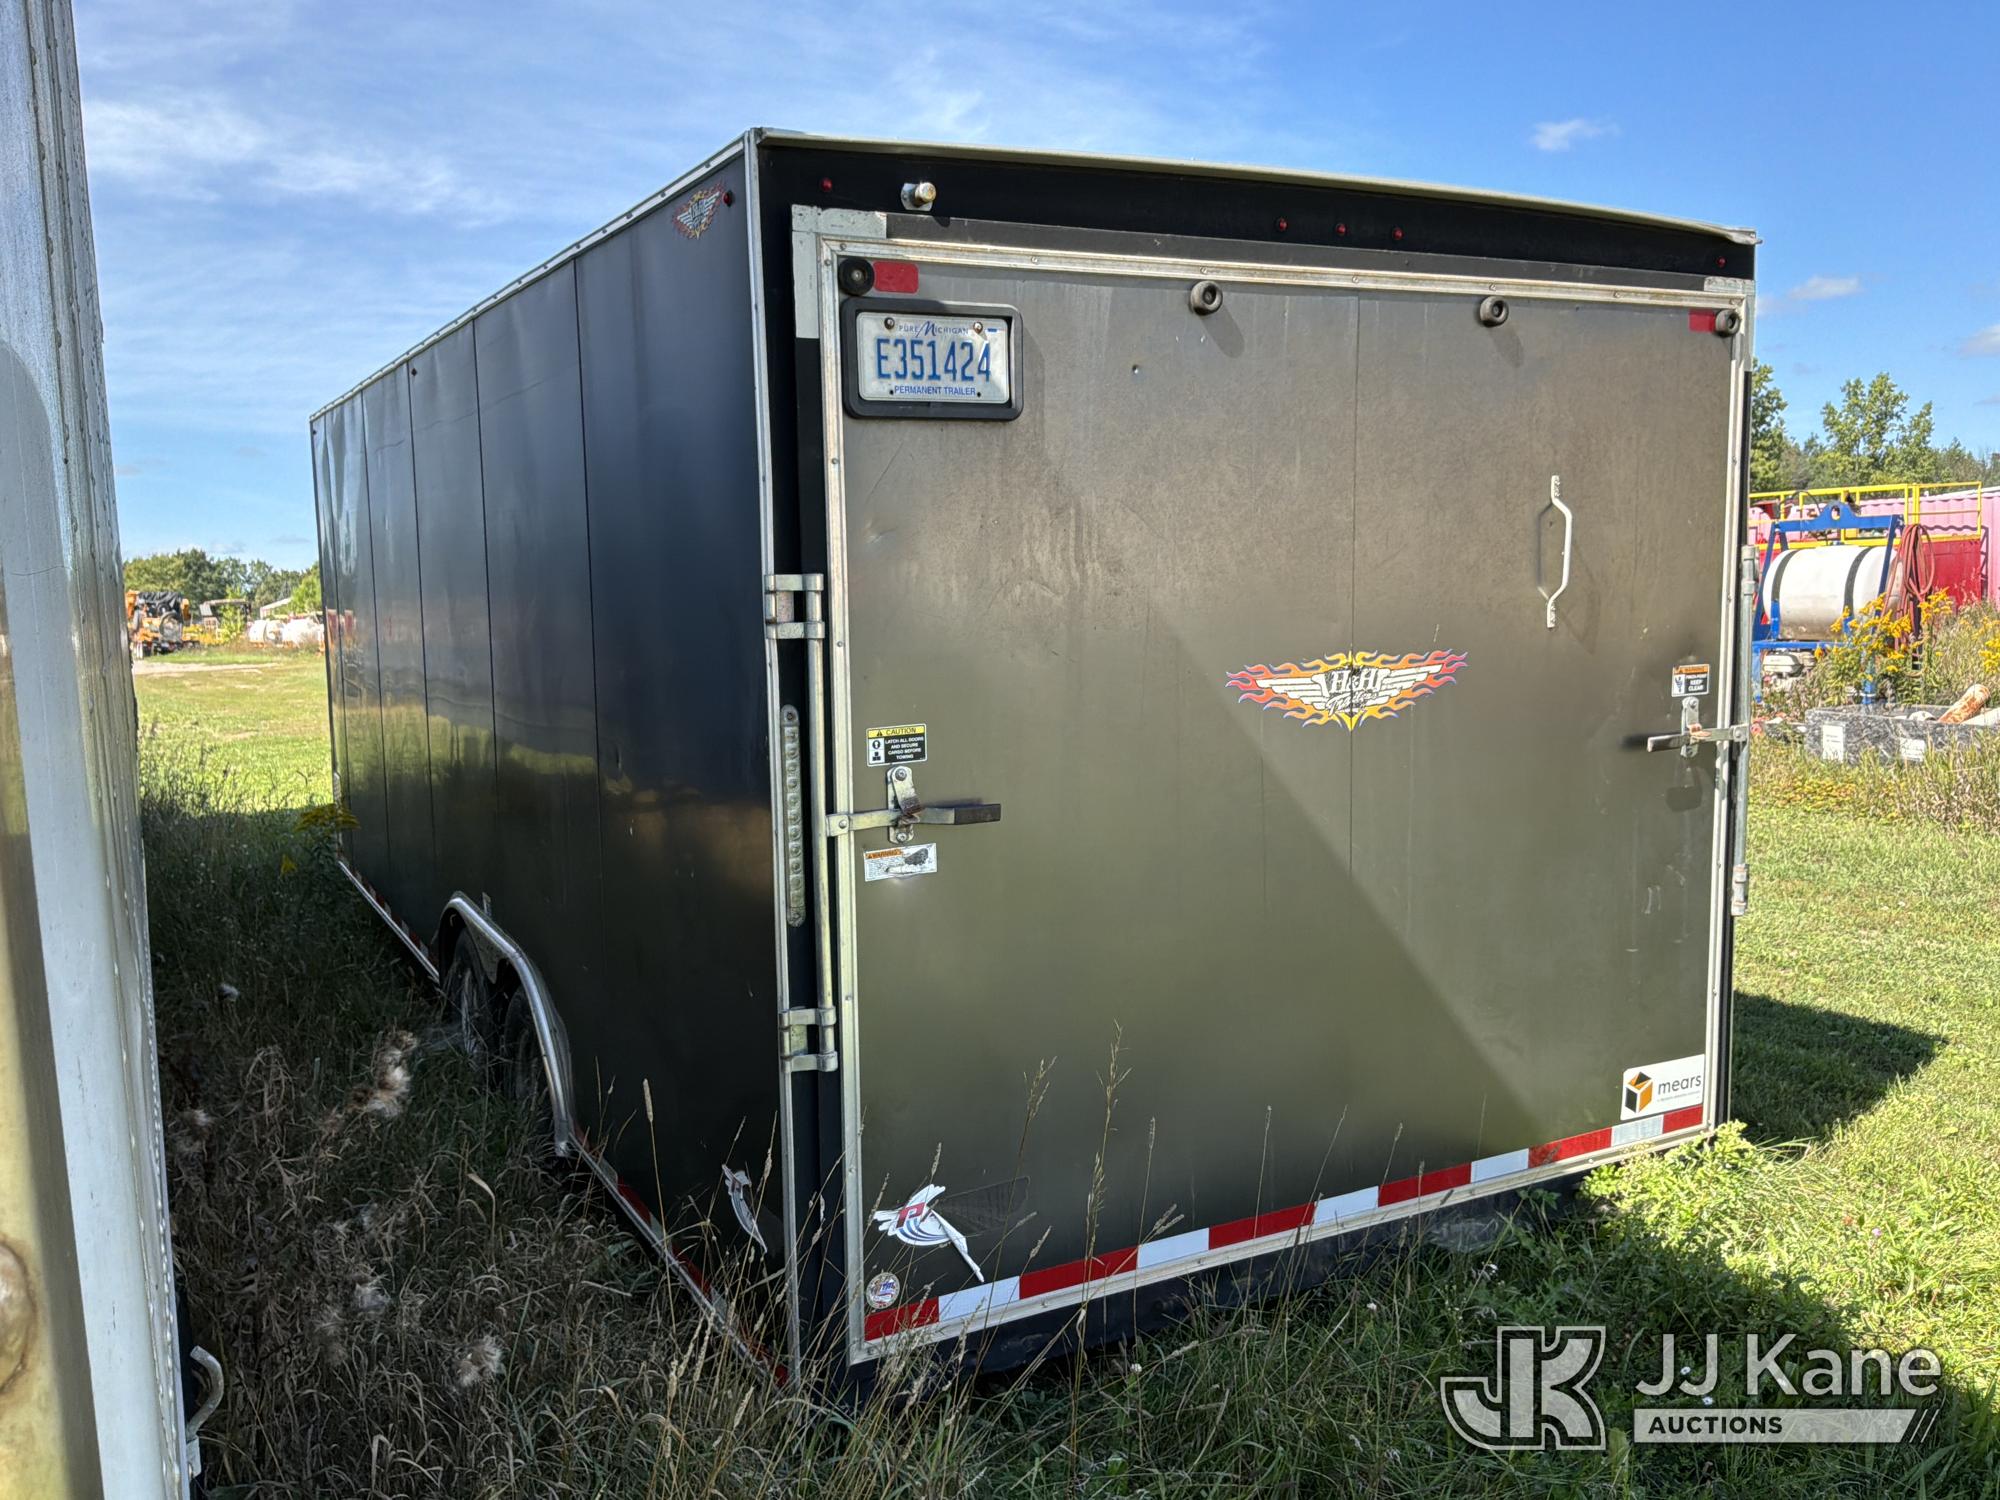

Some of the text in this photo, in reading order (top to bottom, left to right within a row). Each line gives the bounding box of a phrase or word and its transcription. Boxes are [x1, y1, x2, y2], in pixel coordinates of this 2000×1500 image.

[899, 320, 968, 338] PURE MICHIGAN
[876, 338, 991, 382] E351424
[894, 385, 976, 396] PERMANENT TRAILER
[886, 728, 916, 736] CAUTION
[1658, 1075, 1702, 1095] mears
